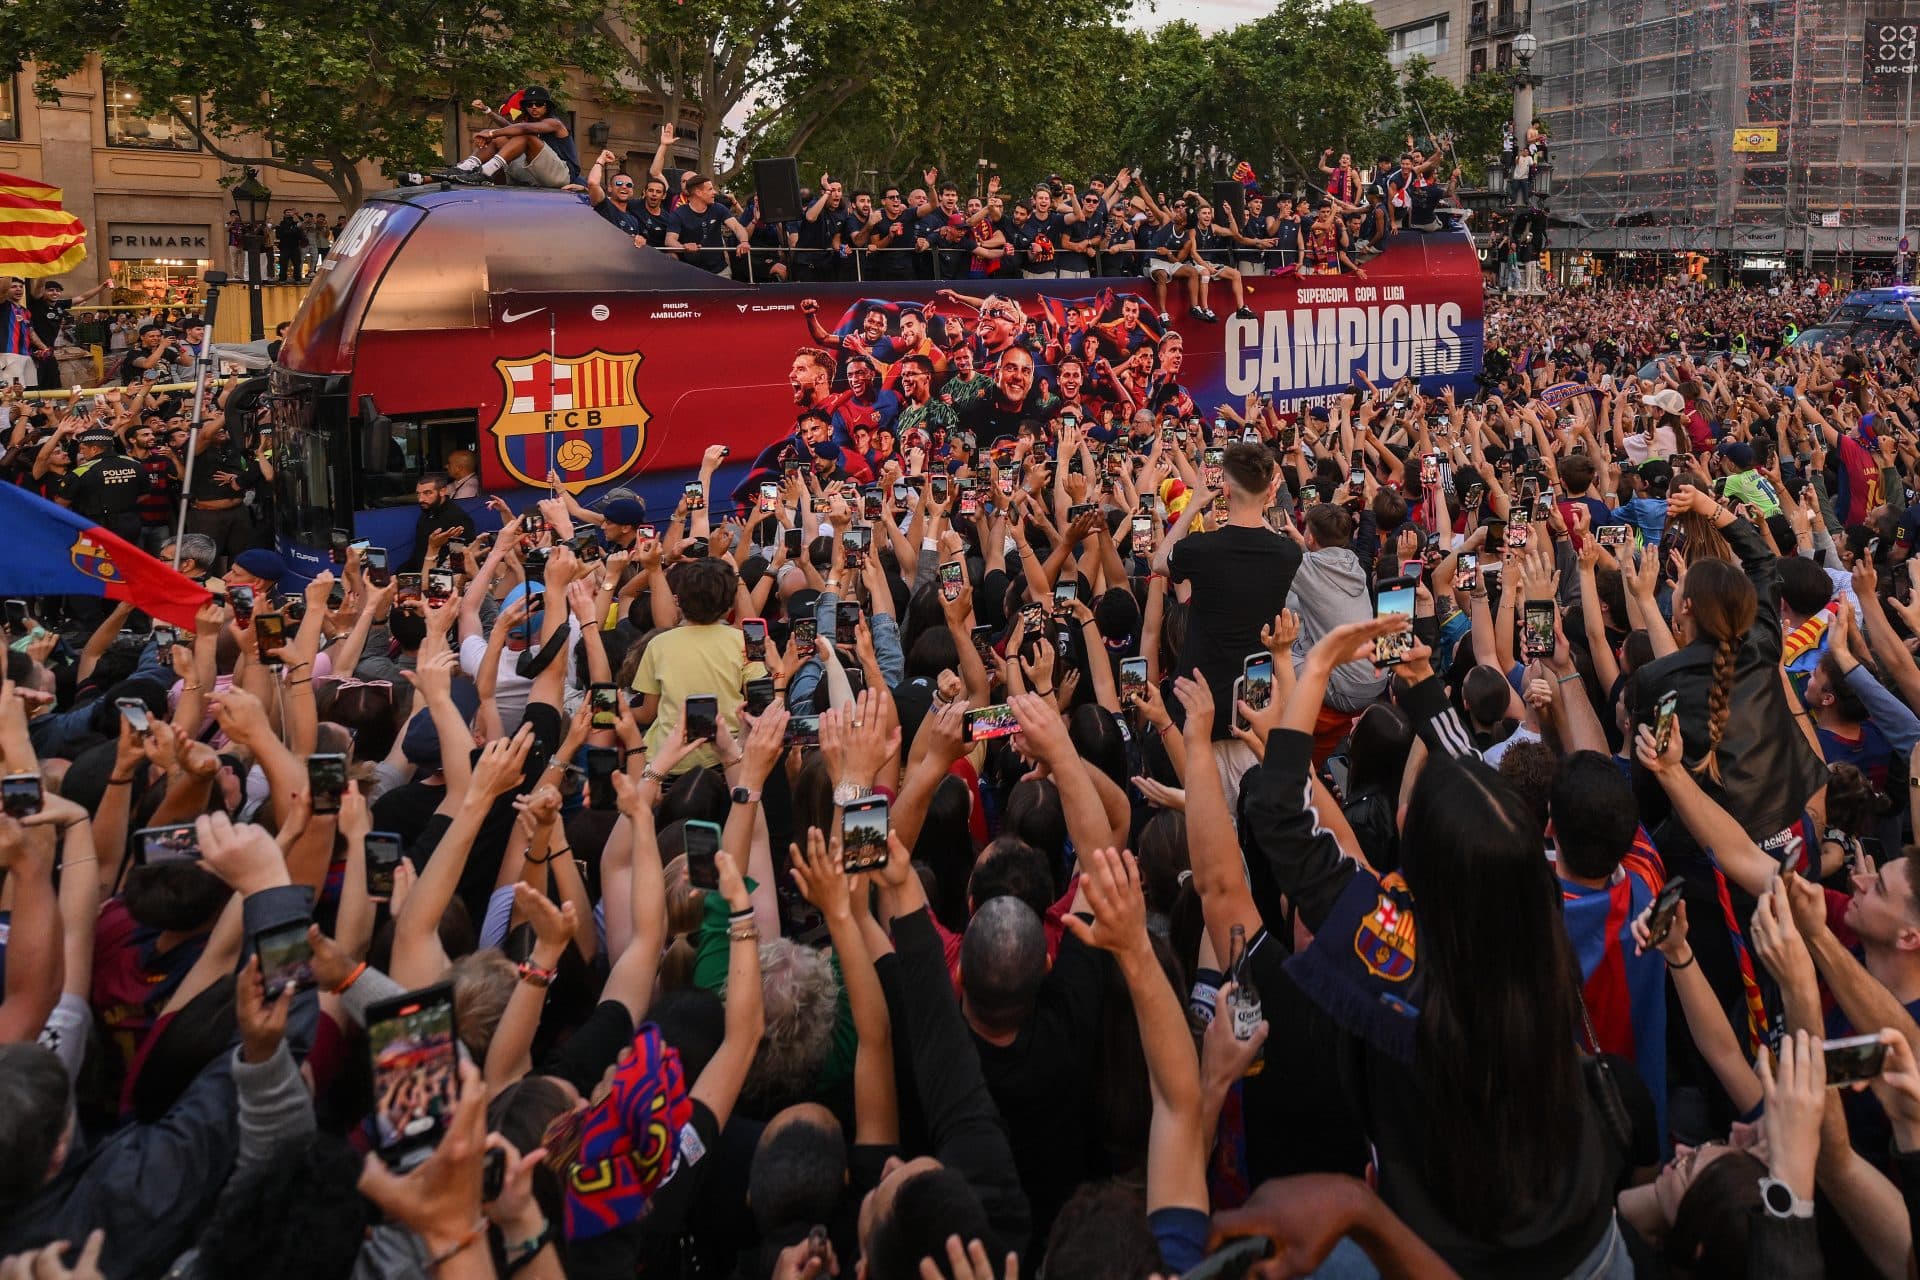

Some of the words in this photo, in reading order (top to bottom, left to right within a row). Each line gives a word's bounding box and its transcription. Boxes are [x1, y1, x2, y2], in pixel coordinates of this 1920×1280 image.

[111, 235, 206, 248] PRIMARK
[1297, 287, 1349, 304] SUPERCOPA
[1355, 286, 1377, 302] COPA
[1383, 286, 1405, 301] LLIGA
[650, 311, 692, 319] AMBILIGHT
[752, 304, 796, 312] CUPRA
[1225, 302, 1462, 397] CAMPIONS
[1280, 399, 1290, 415] EL
